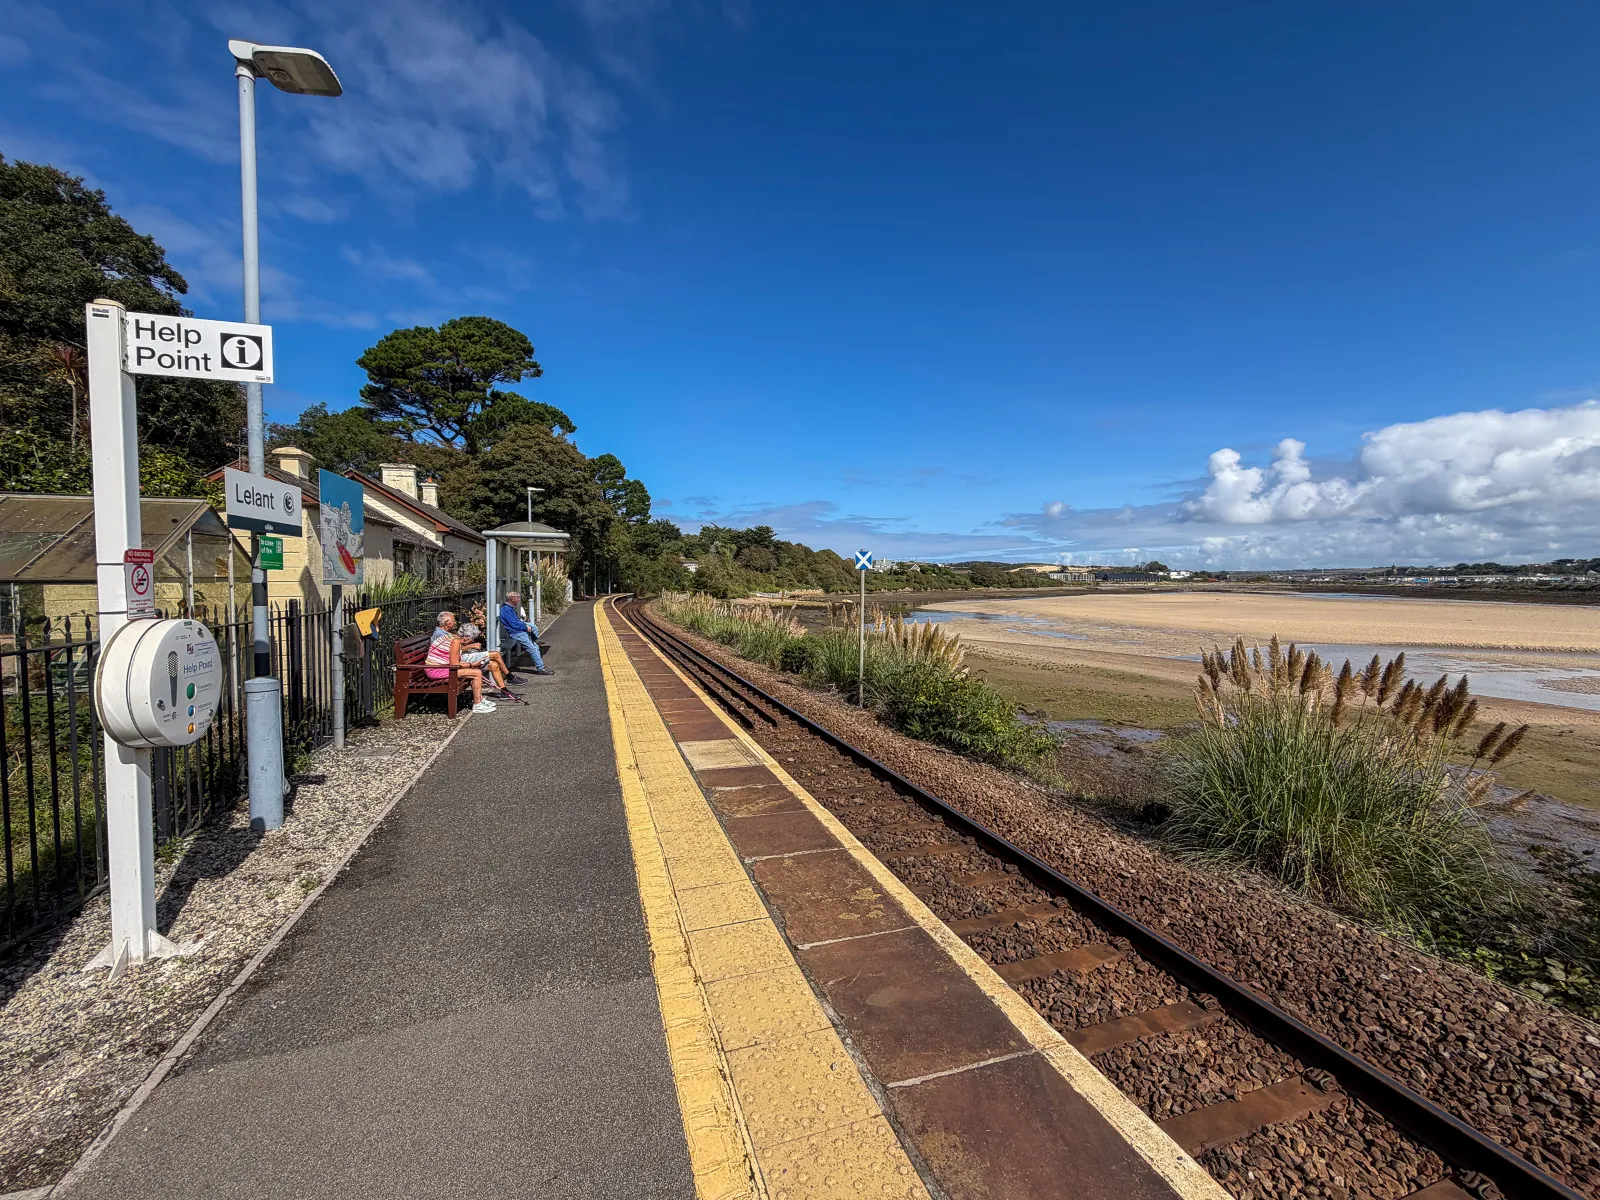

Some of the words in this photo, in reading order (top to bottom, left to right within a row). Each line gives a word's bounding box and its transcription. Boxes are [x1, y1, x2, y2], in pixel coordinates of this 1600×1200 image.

[135, 319, 201, 348] Help
[136, 346, 211, 372] Point
[236, 483, 275, 510] Lelant
[184, 662, 198, 674] Help
[199, 660, 213, 671] Point
